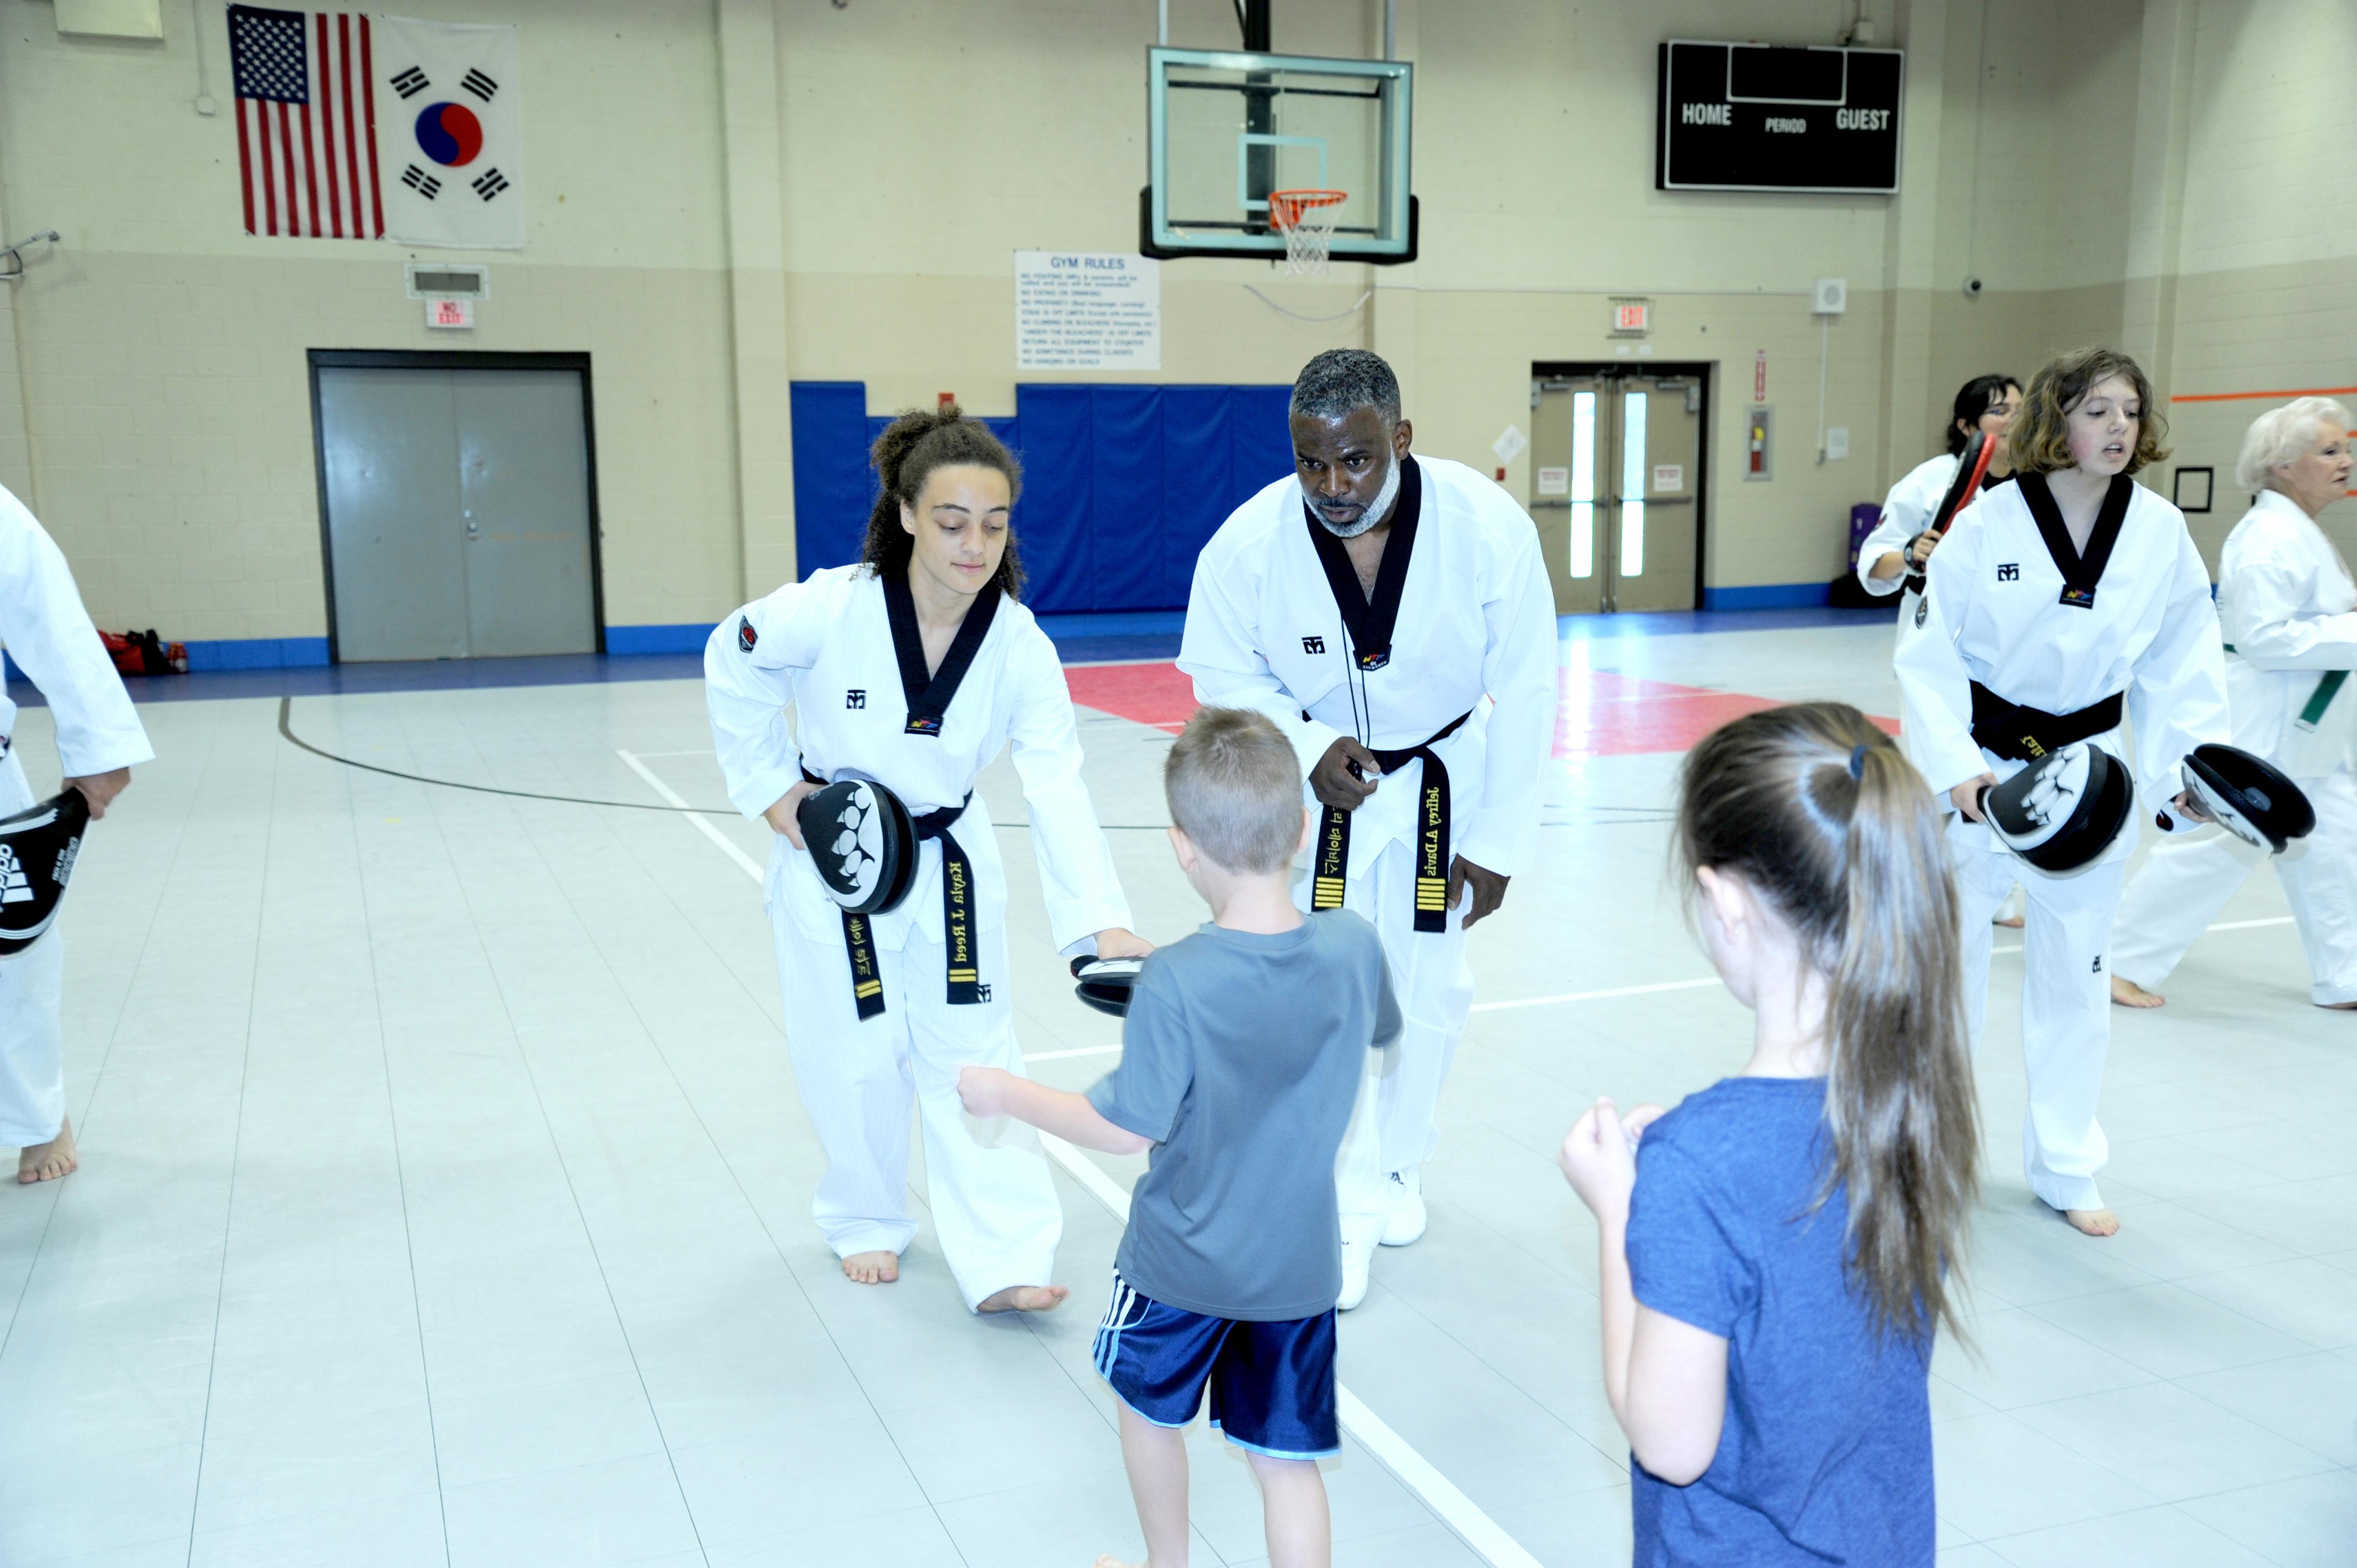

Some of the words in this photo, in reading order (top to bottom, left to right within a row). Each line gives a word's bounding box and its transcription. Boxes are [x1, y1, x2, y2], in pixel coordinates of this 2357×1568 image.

[1682, 104, 1732, 125] HOME
[1765, 117, 1807, 133] PERIOD
[1836, 108, 1890, 131] GUEST
[1051, 256, 1078, 269] GYM
[1084, 257, 1125, 270] RULES
[1621, 306, 1643, 327] EXIT
